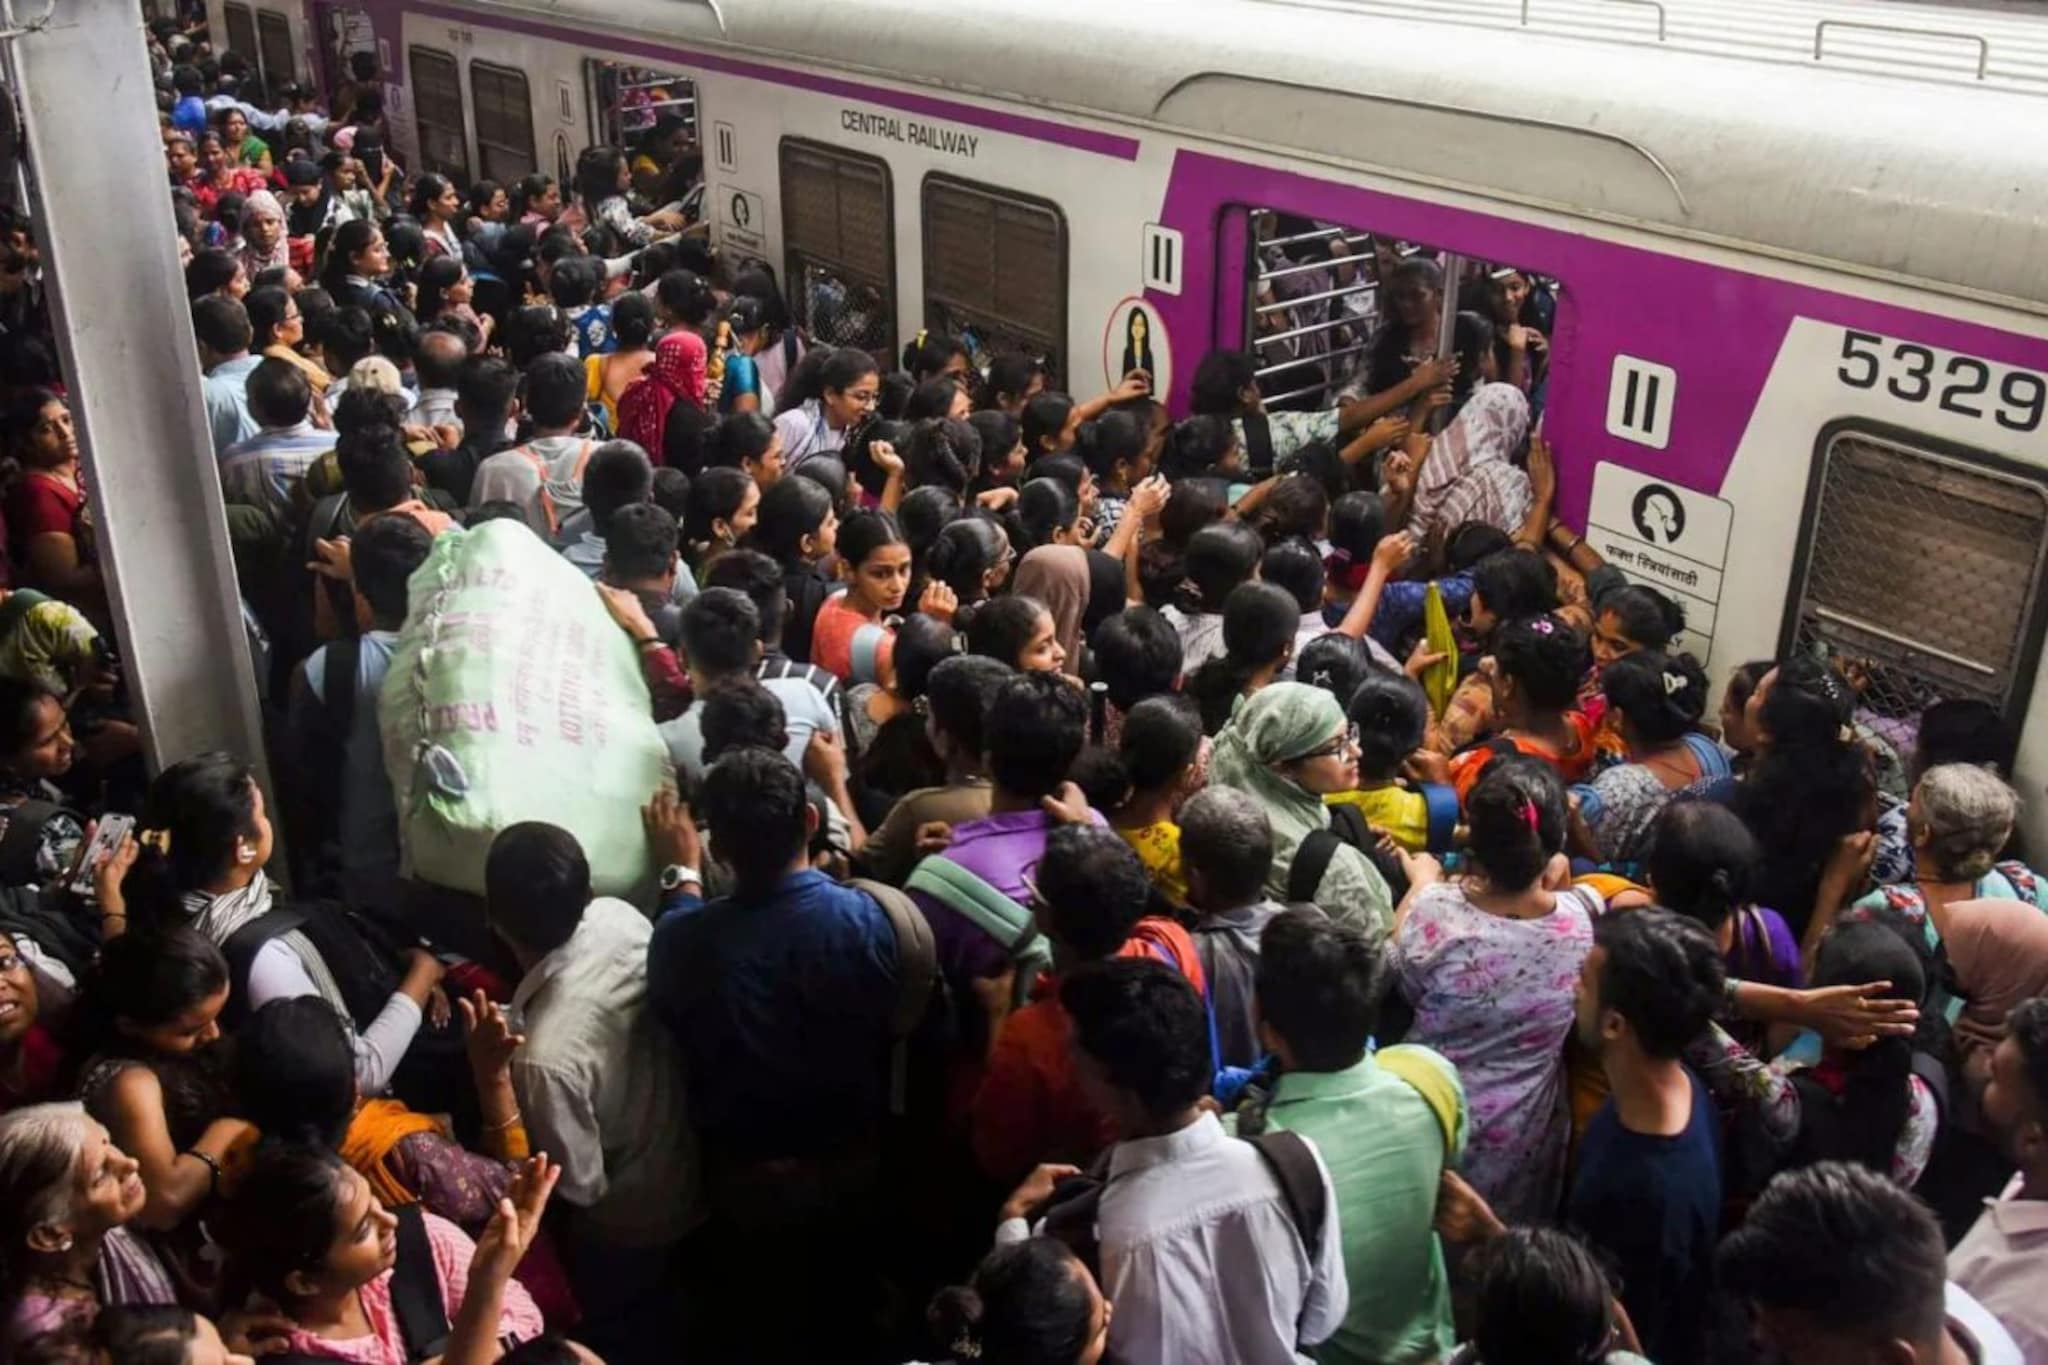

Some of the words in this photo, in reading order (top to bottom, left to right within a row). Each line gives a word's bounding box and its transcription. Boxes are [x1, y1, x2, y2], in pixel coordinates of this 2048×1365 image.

[841, 109, 904, 142] CENTRAL
[908, 123, 978, 157] RAILWAY
[1838, 329, 2047, 432] 5329
[1605, 543, 1634, 564] फक्त
